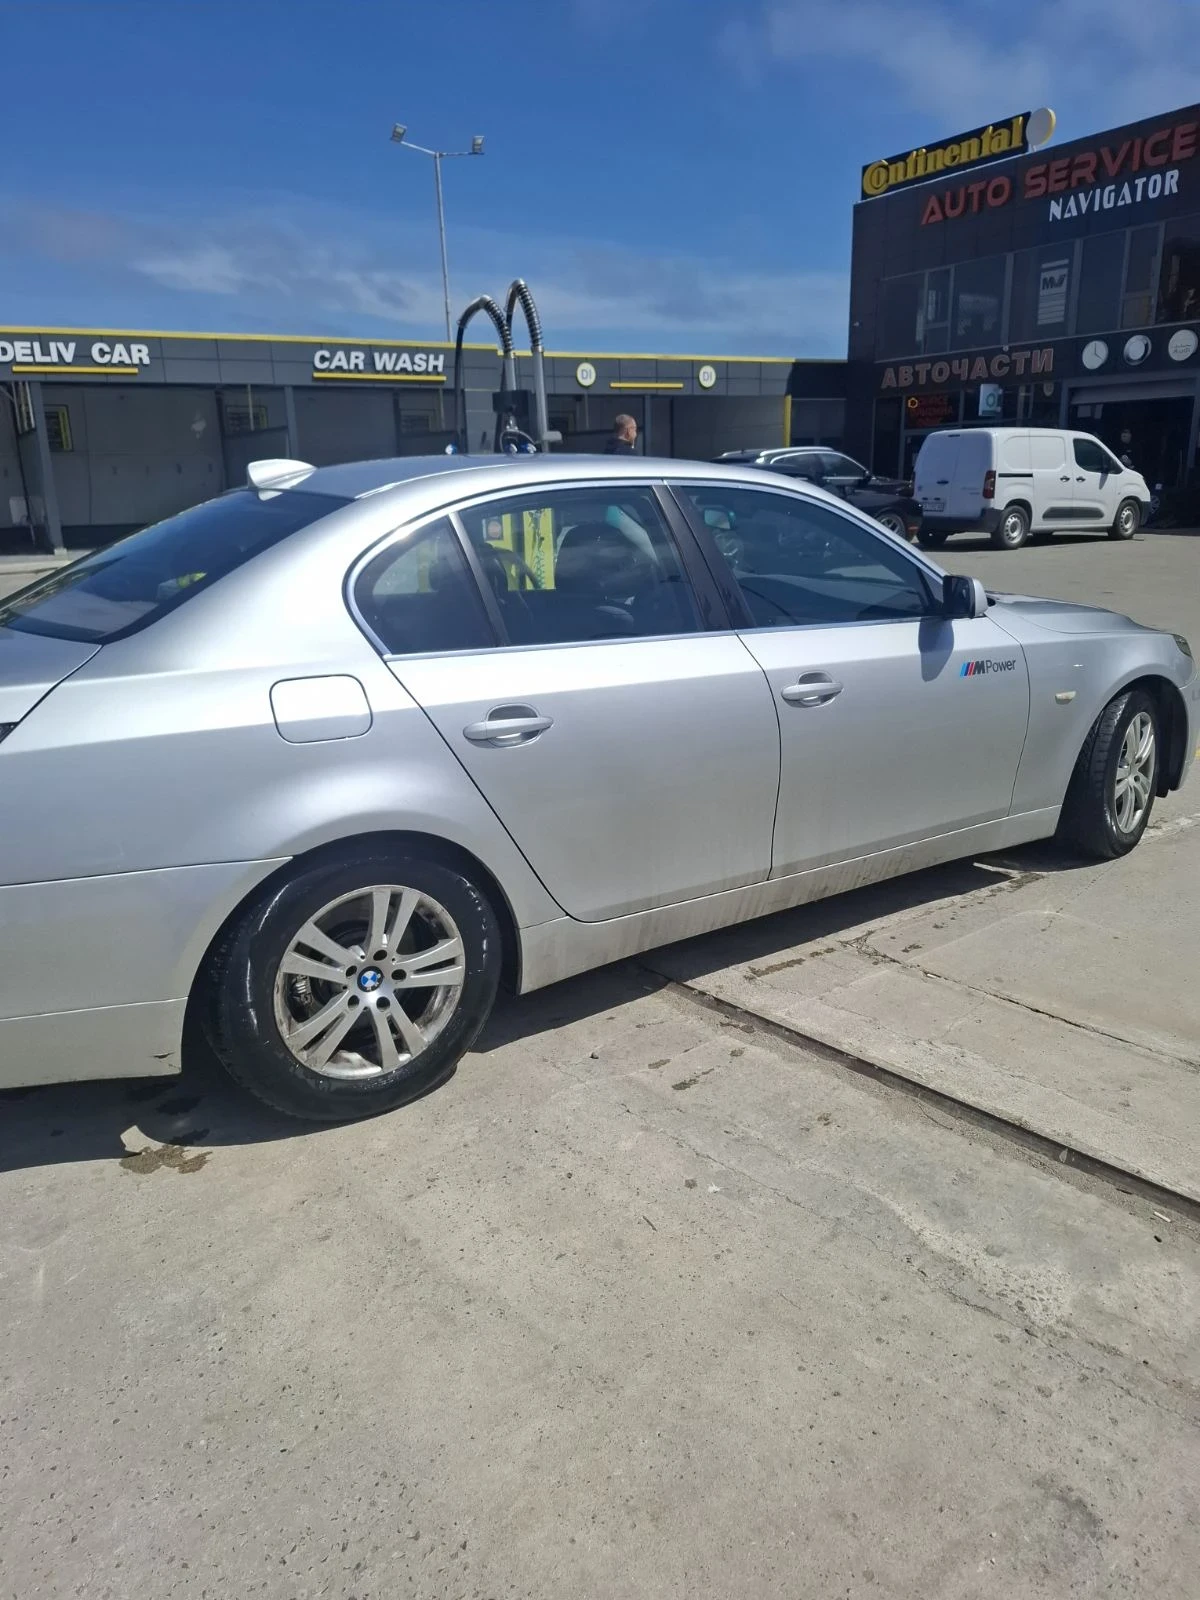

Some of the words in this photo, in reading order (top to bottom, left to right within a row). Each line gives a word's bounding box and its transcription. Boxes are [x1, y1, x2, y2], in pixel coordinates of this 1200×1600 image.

[862, 115, 1023, 196] Continental
[920, 175, 1012, 226] AUTO
[1024, 122, 1199, 200] SERVICE
[1049, 168, 1180, 222] NAVIGATOR
[0, 341, 76, 363] DELIV
[90, 342, 150, 365] CAR
[313, 349, 365, 371] CAR
[374, 351, 445, 373] WASH
[881, 348, 1055, 390] АВТОЧАСТИ
